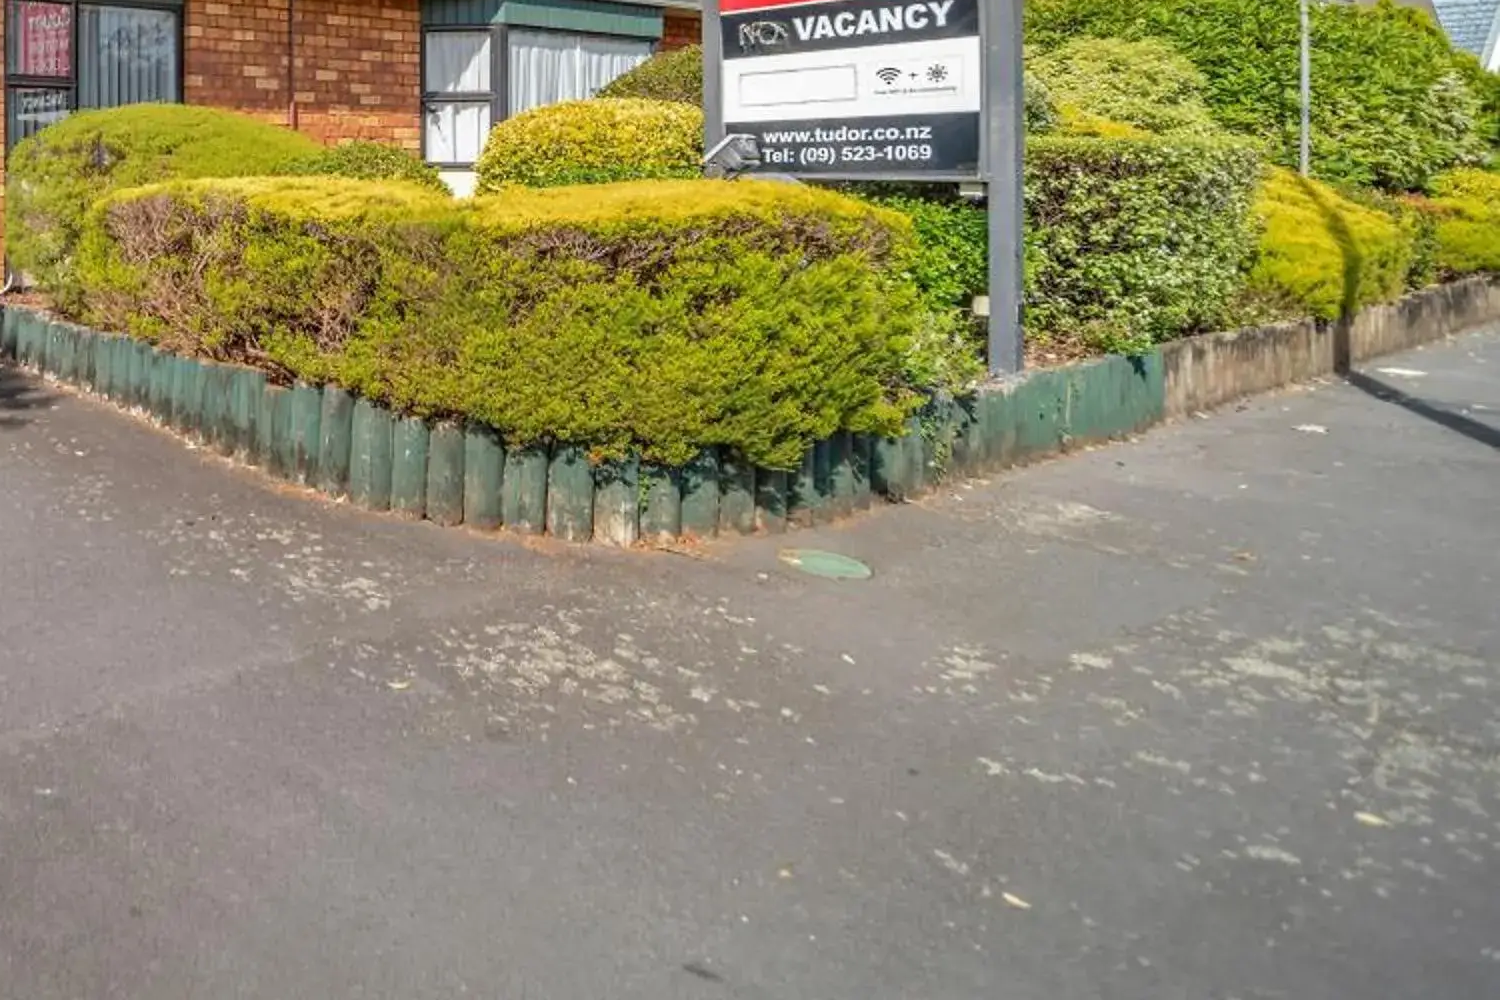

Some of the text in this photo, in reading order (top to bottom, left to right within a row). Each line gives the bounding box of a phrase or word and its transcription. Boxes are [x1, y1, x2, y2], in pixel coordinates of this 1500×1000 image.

[791, 0, 955, 41] VACANCY
[762, 125, 933, 144] www.tudor.co.nz
[763, 145, 933, 166] Tel: (09) 523-1069
